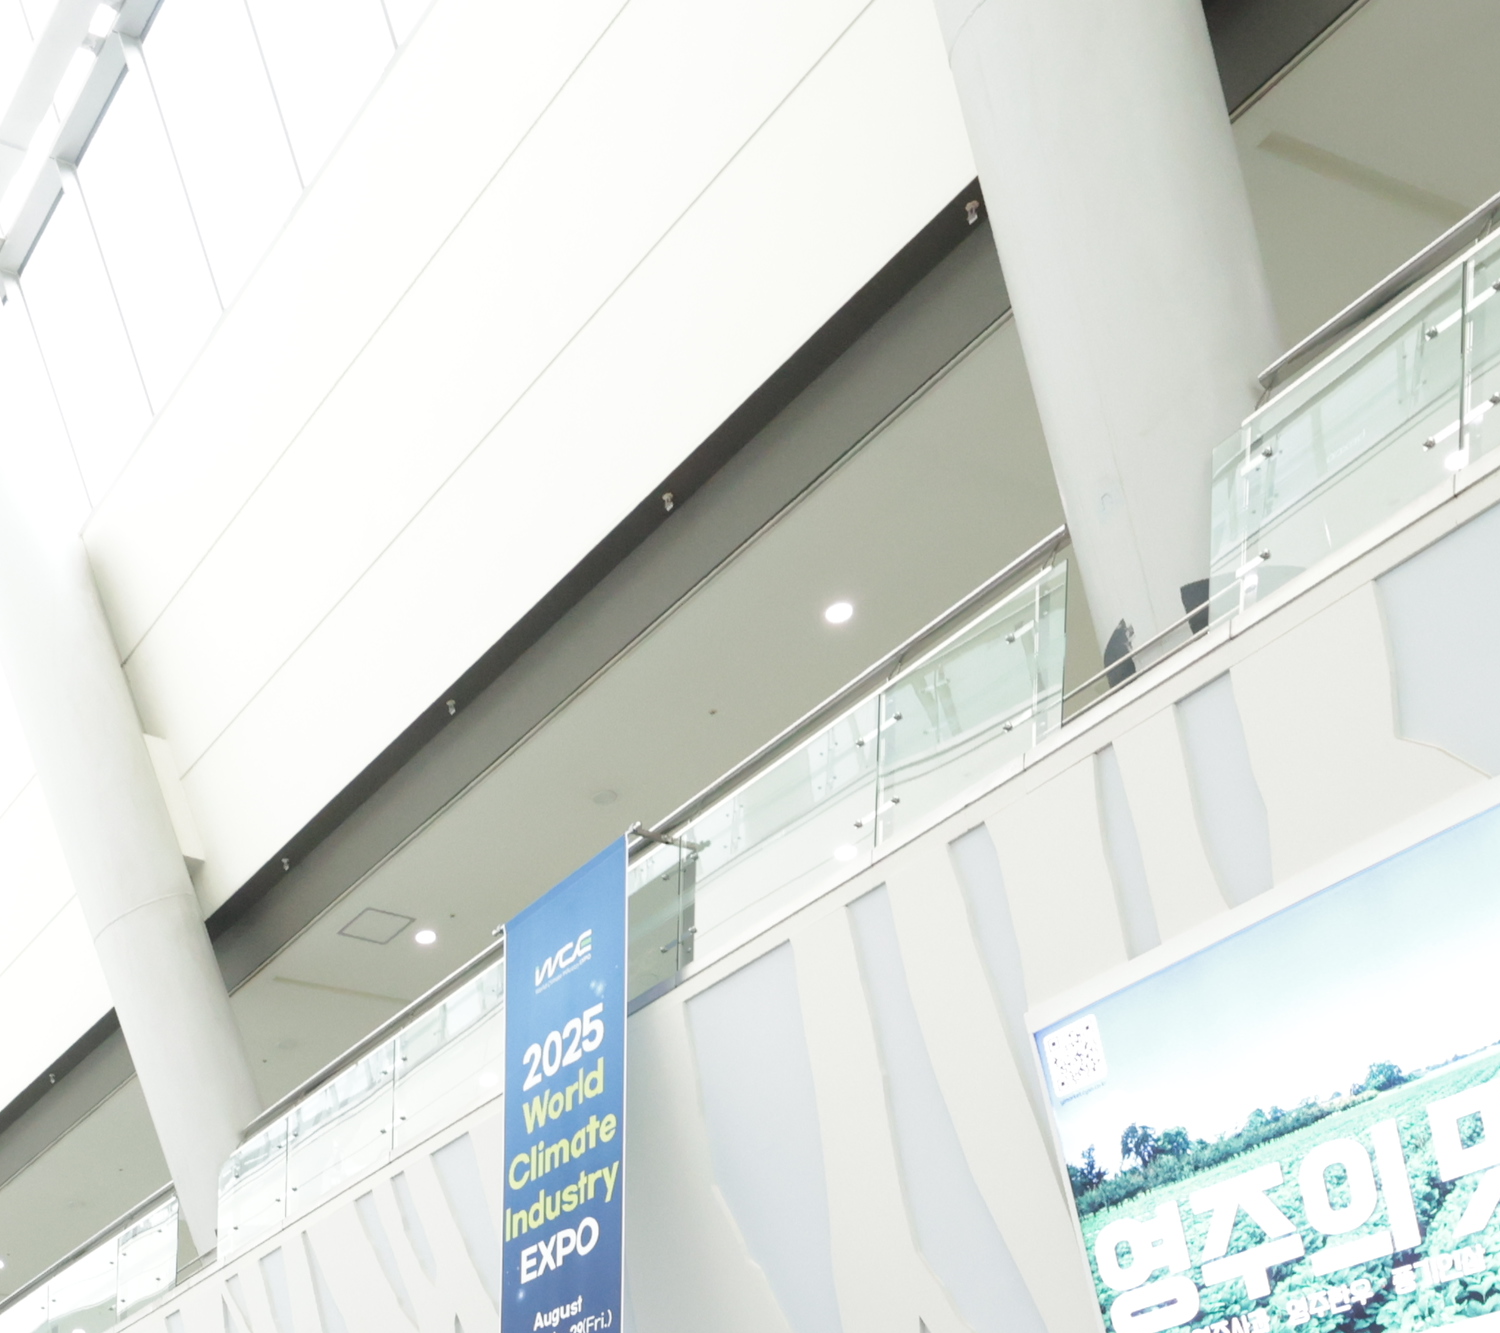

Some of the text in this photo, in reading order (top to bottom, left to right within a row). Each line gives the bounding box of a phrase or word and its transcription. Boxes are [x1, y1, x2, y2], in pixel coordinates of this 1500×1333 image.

[535, 929, 592, 987] WCE
[522, 1003, 604, 1092] 2025
[522, 1057, 604, 1134] World
[508, 1113, 617, 1190] Climate
[504, 1161, 620, 1241] Industry
[519, 1216, 600, 1285] EXPO
[533, 1295, 583, 1332] August
